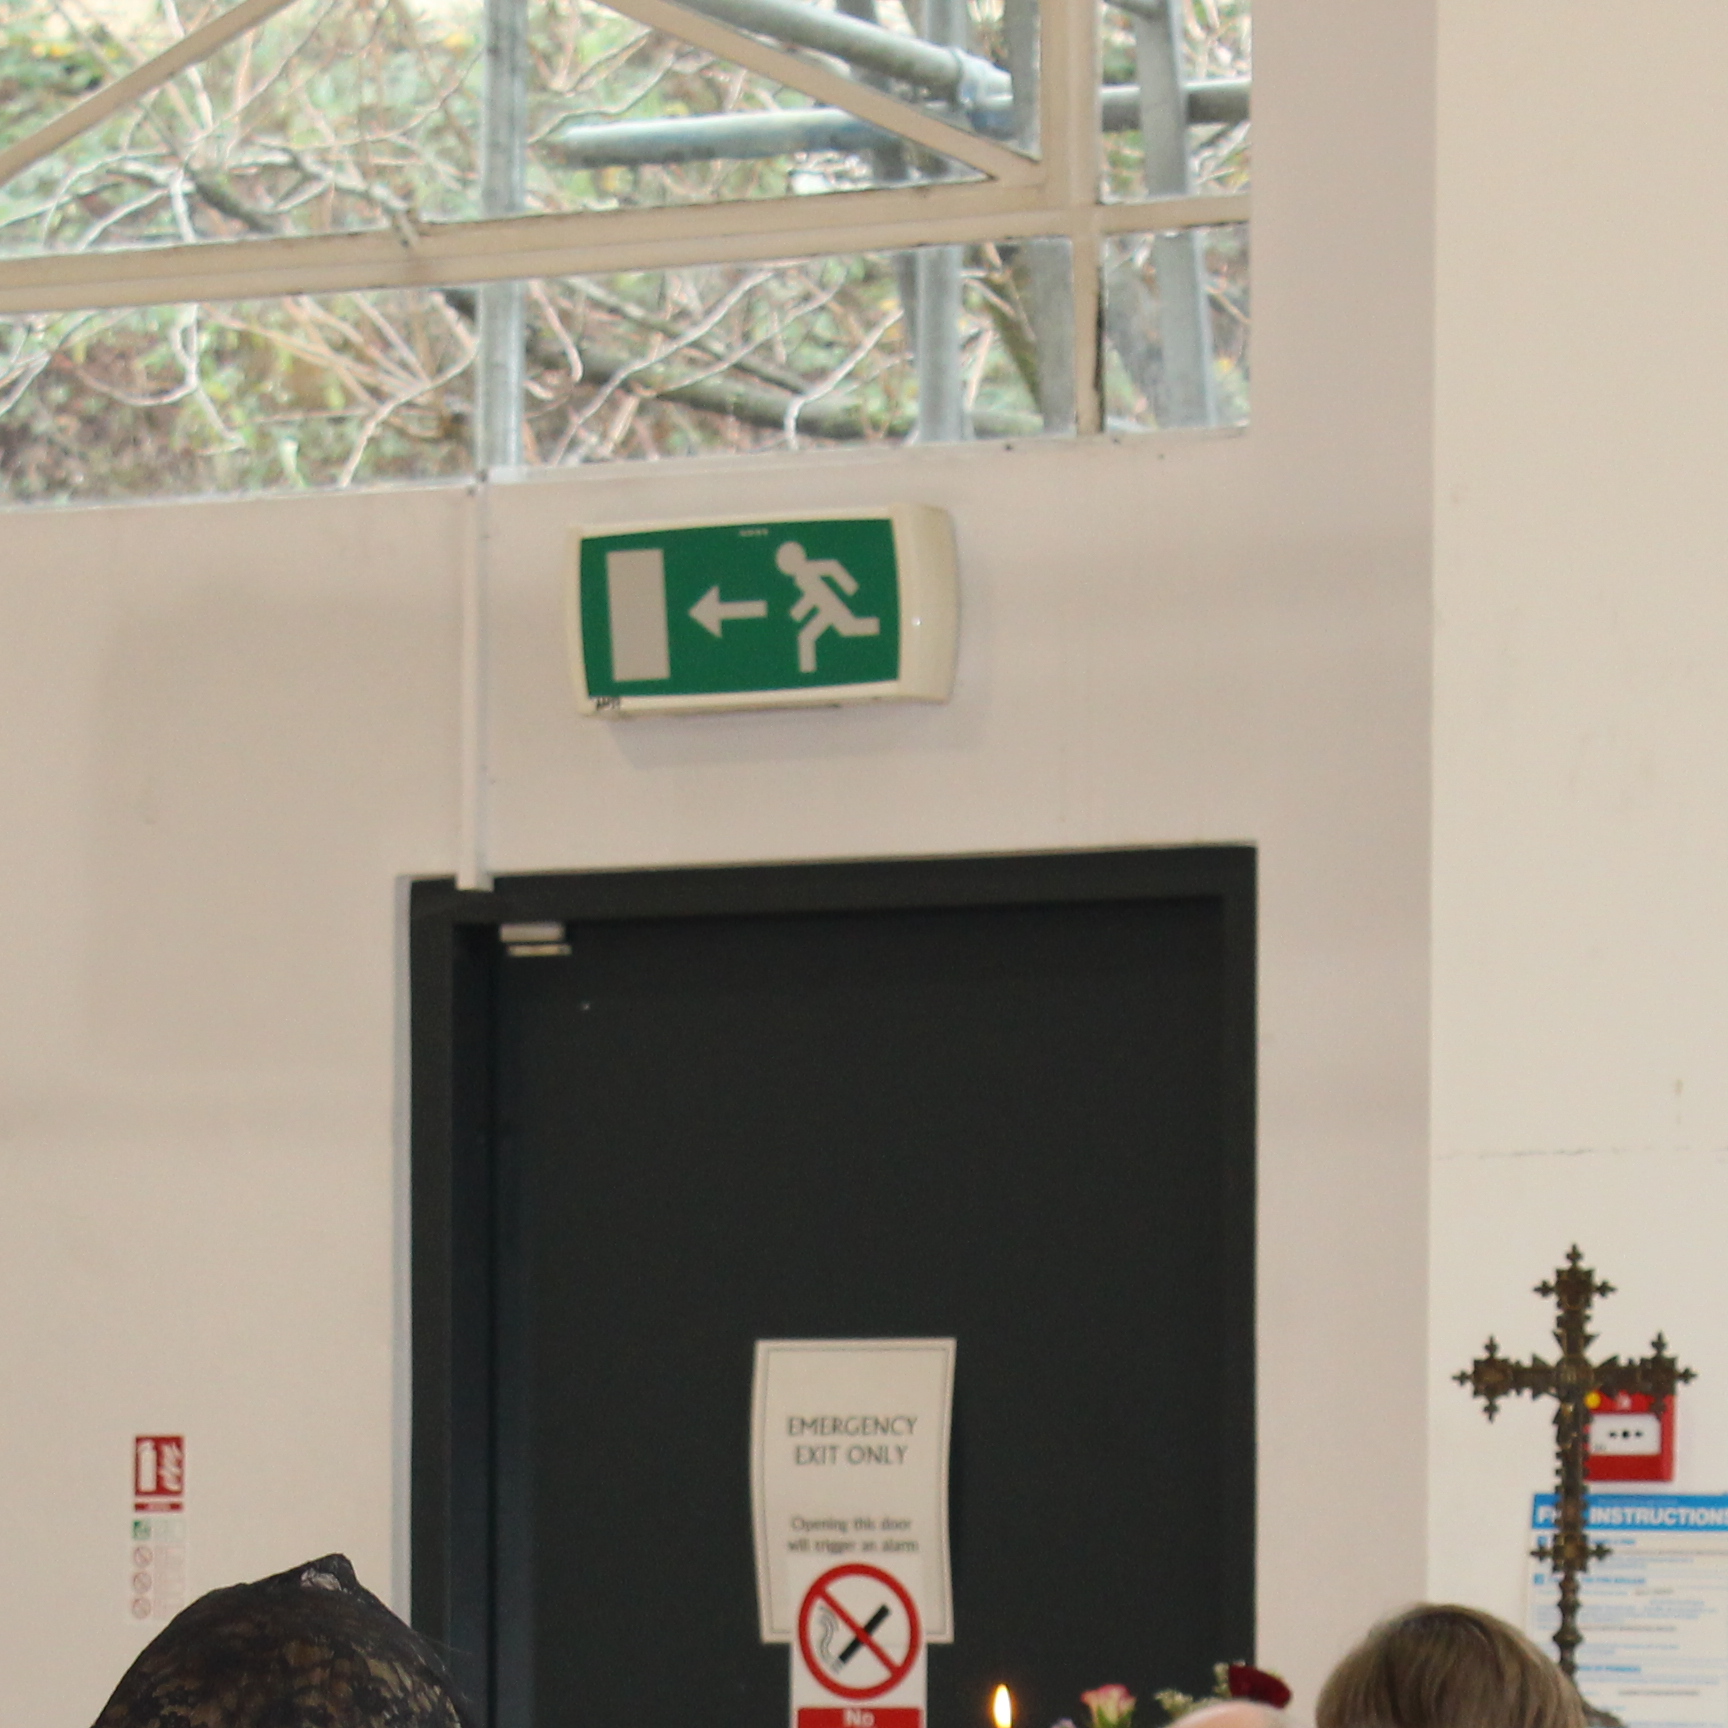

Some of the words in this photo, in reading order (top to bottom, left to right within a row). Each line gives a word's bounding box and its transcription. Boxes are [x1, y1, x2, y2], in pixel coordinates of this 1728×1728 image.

[787, 1415, 917, 1435] EMERGENCY
[795, 1445, 838, 1464] EXIT
[847, 1445, 907, 1464] ONLY
[791, 1516, 847, 1532] Opening
[881, 1517, 910, 1529] door
[843, 1708, 874, 1728] No
